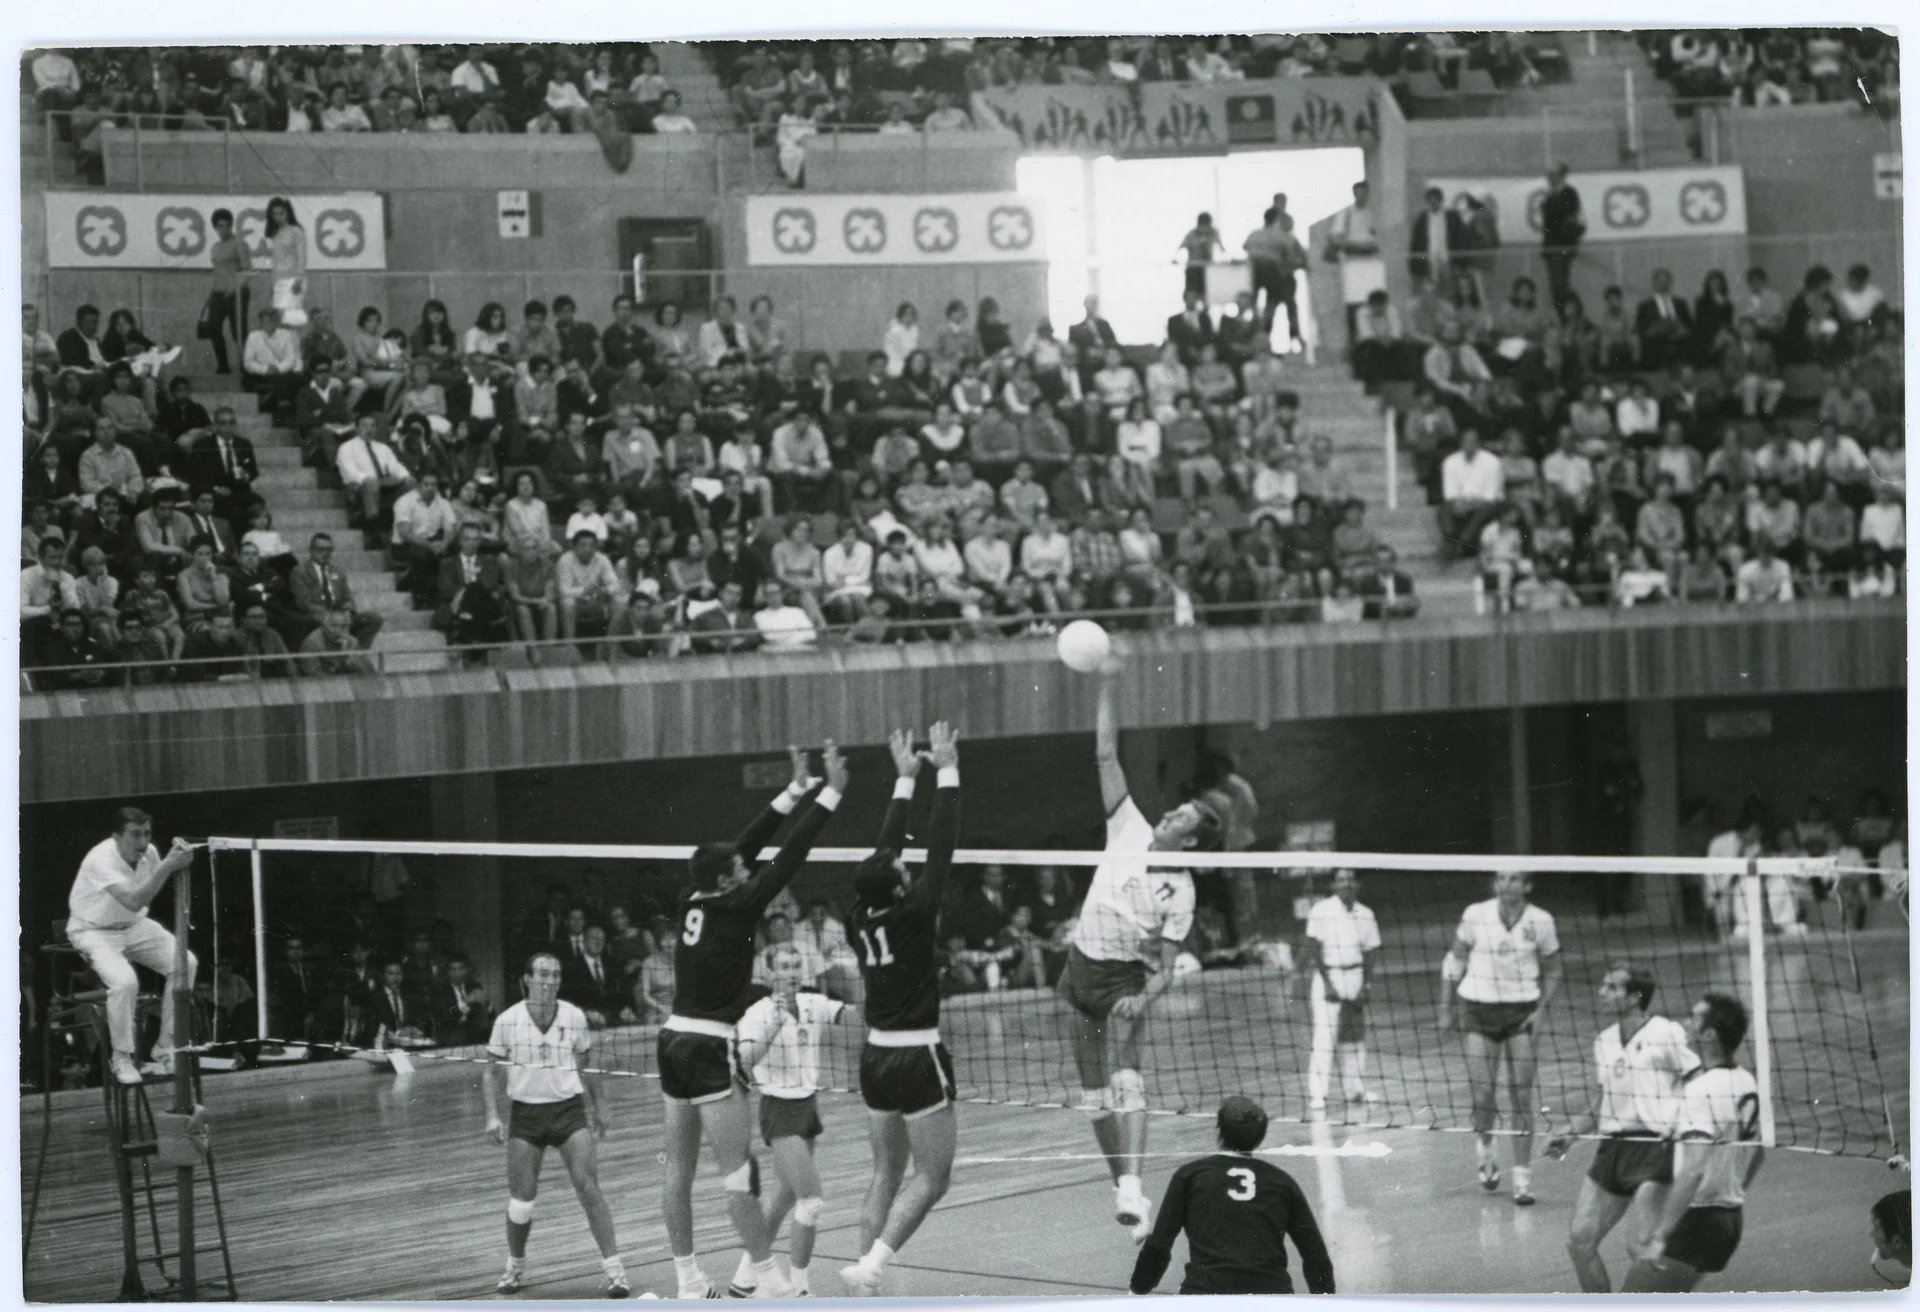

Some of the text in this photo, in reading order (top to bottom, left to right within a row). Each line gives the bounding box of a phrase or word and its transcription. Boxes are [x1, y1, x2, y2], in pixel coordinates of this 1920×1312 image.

[682, 908, 704, 946] 9
[859, 926, 894, 966] 11
[1737, 1092, 1760, 1141] 2
[1227, 1167, 1256, 1201] 3
